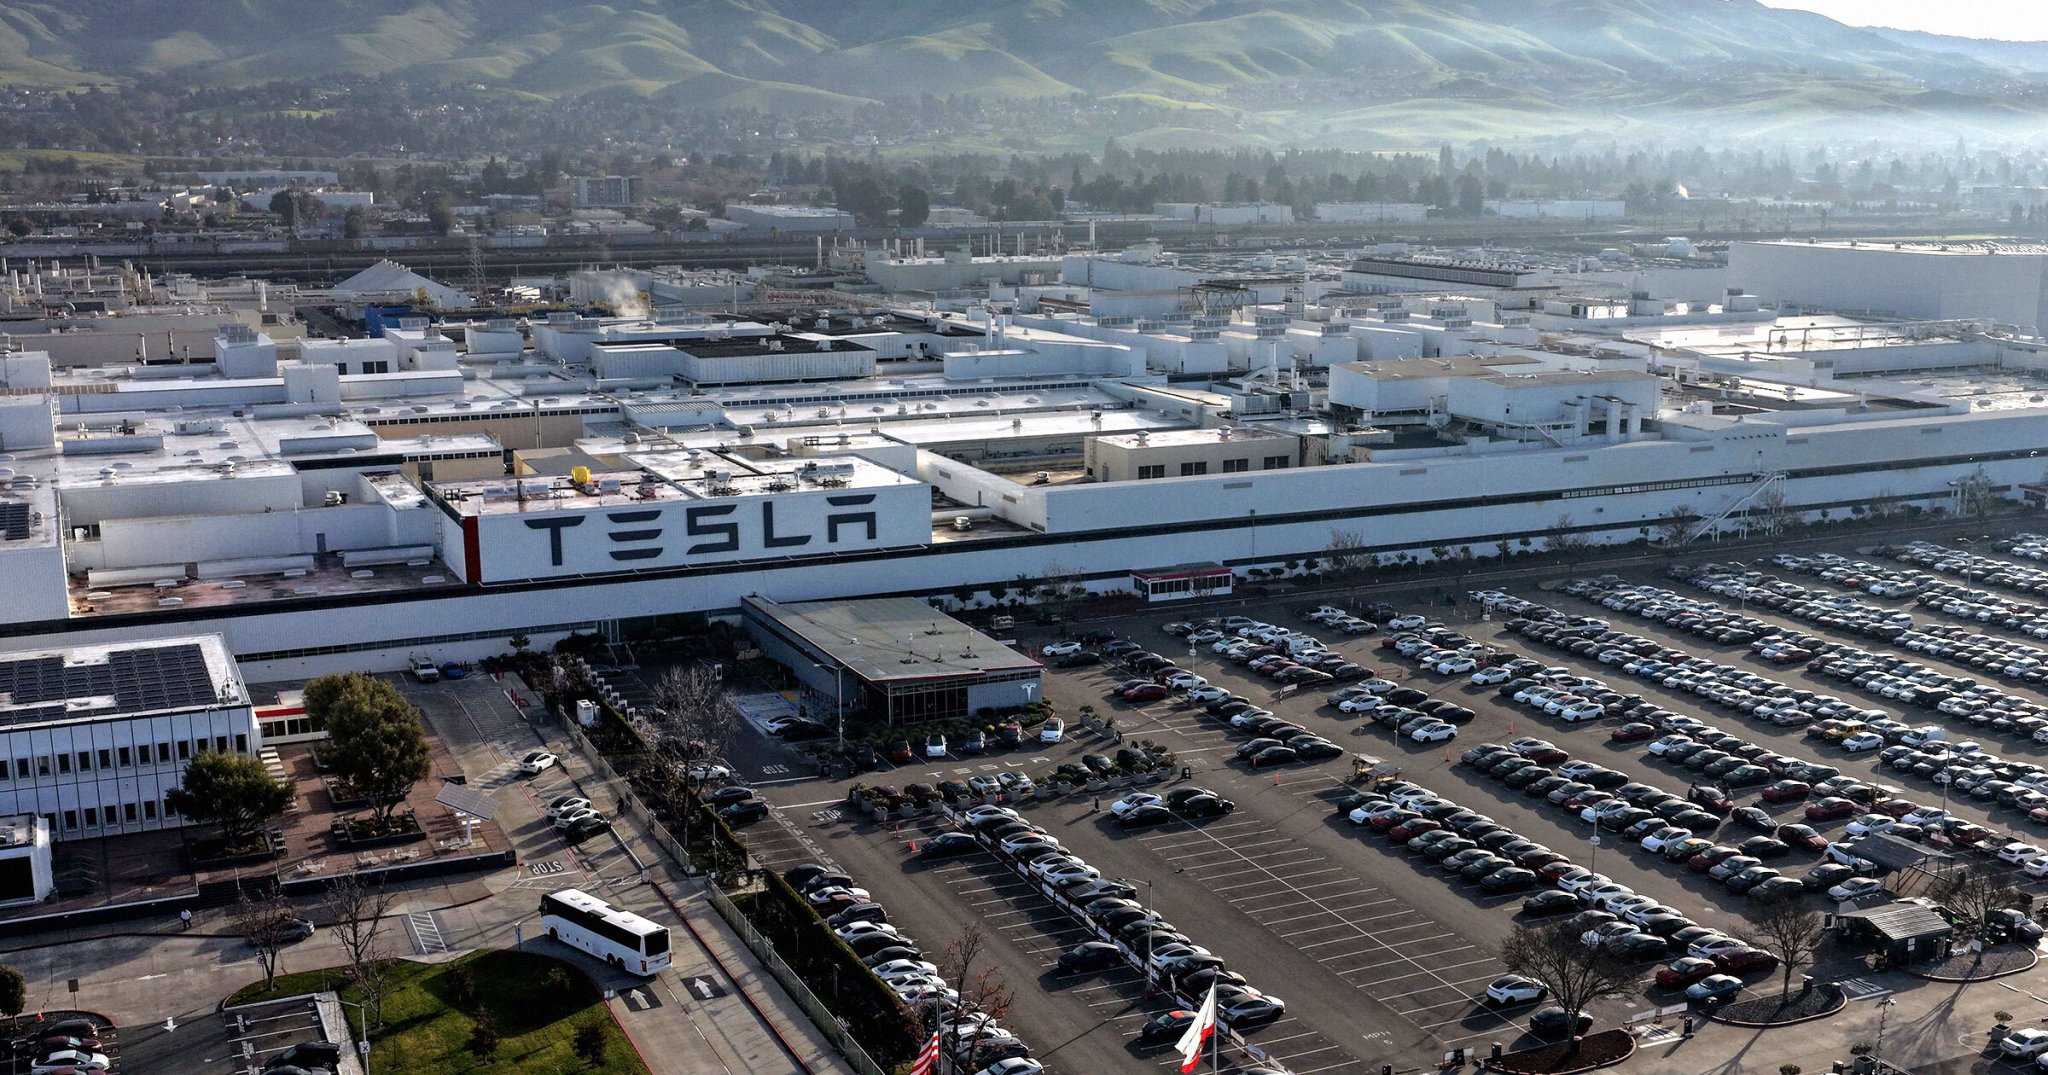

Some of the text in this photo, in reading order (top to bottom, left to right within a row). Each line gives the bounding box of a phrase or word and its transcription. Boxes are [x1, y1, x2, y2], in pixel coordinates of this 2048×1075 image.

[524, 494, 877, 567] TESLA
[762, 764, 790, 775] STOP
[925, 756, 1050, 778] TESLA
[812, 809, 842, 821] STOP
[532, 861, 563, 875] STOP
